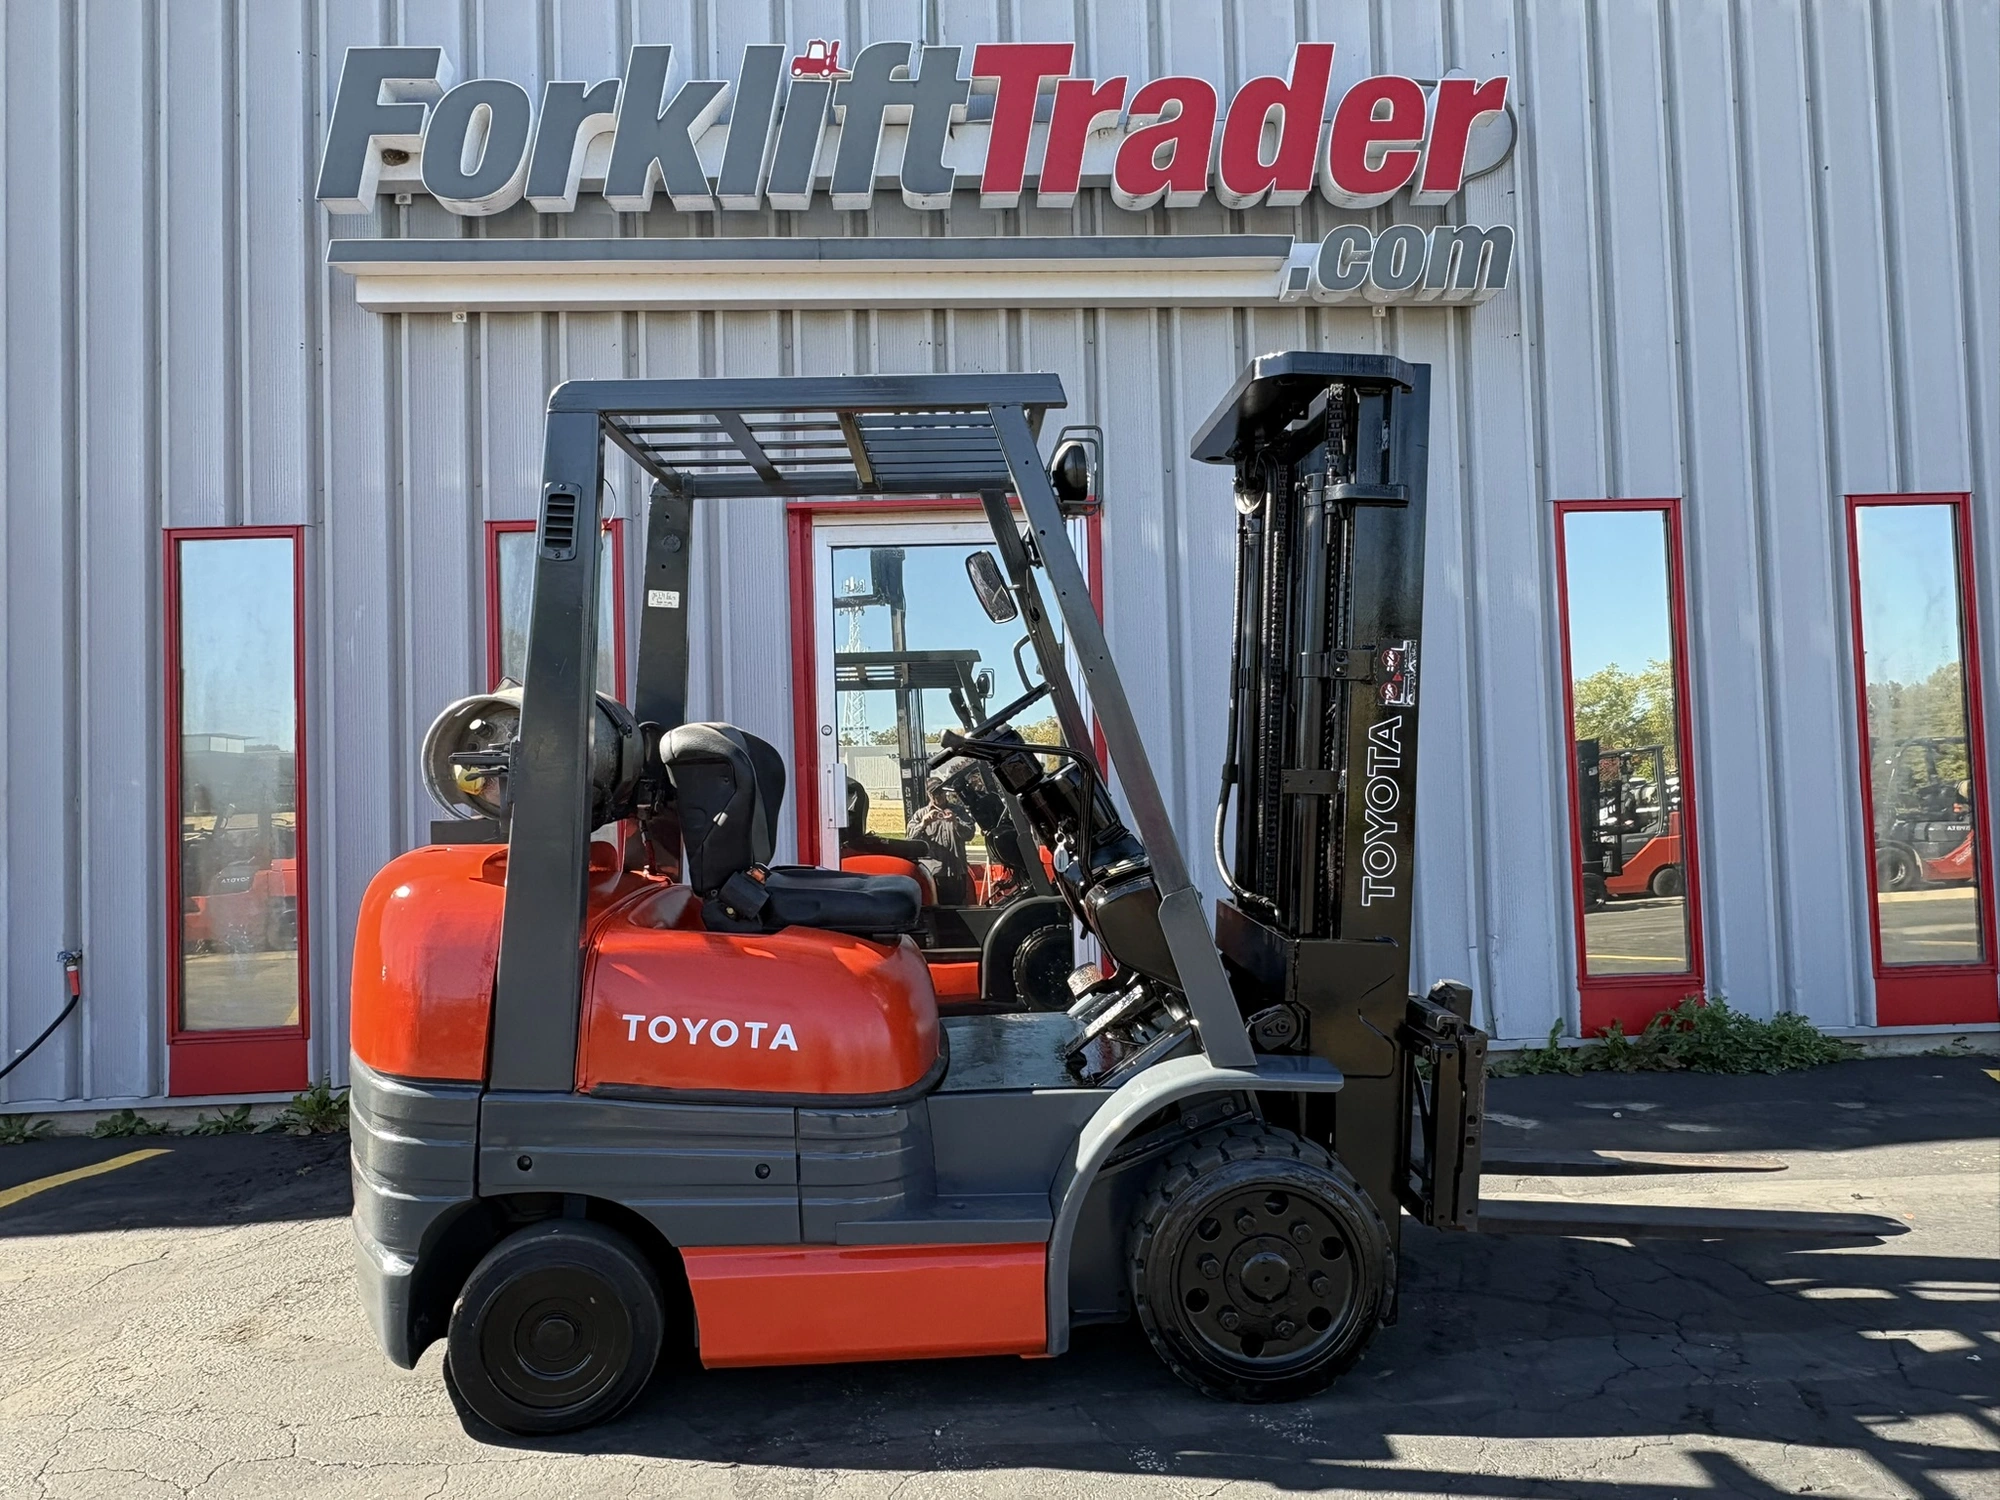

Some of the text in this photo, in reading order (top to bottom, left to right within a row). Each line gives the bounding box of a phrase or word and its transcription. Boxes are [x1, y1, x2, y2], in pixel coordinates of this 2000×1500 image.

[1287, 224, 1515, 294] .com
[1362, 715, 1402, 906] TOYOTA
[622, 1014, 798, 1050] TOYOTA
